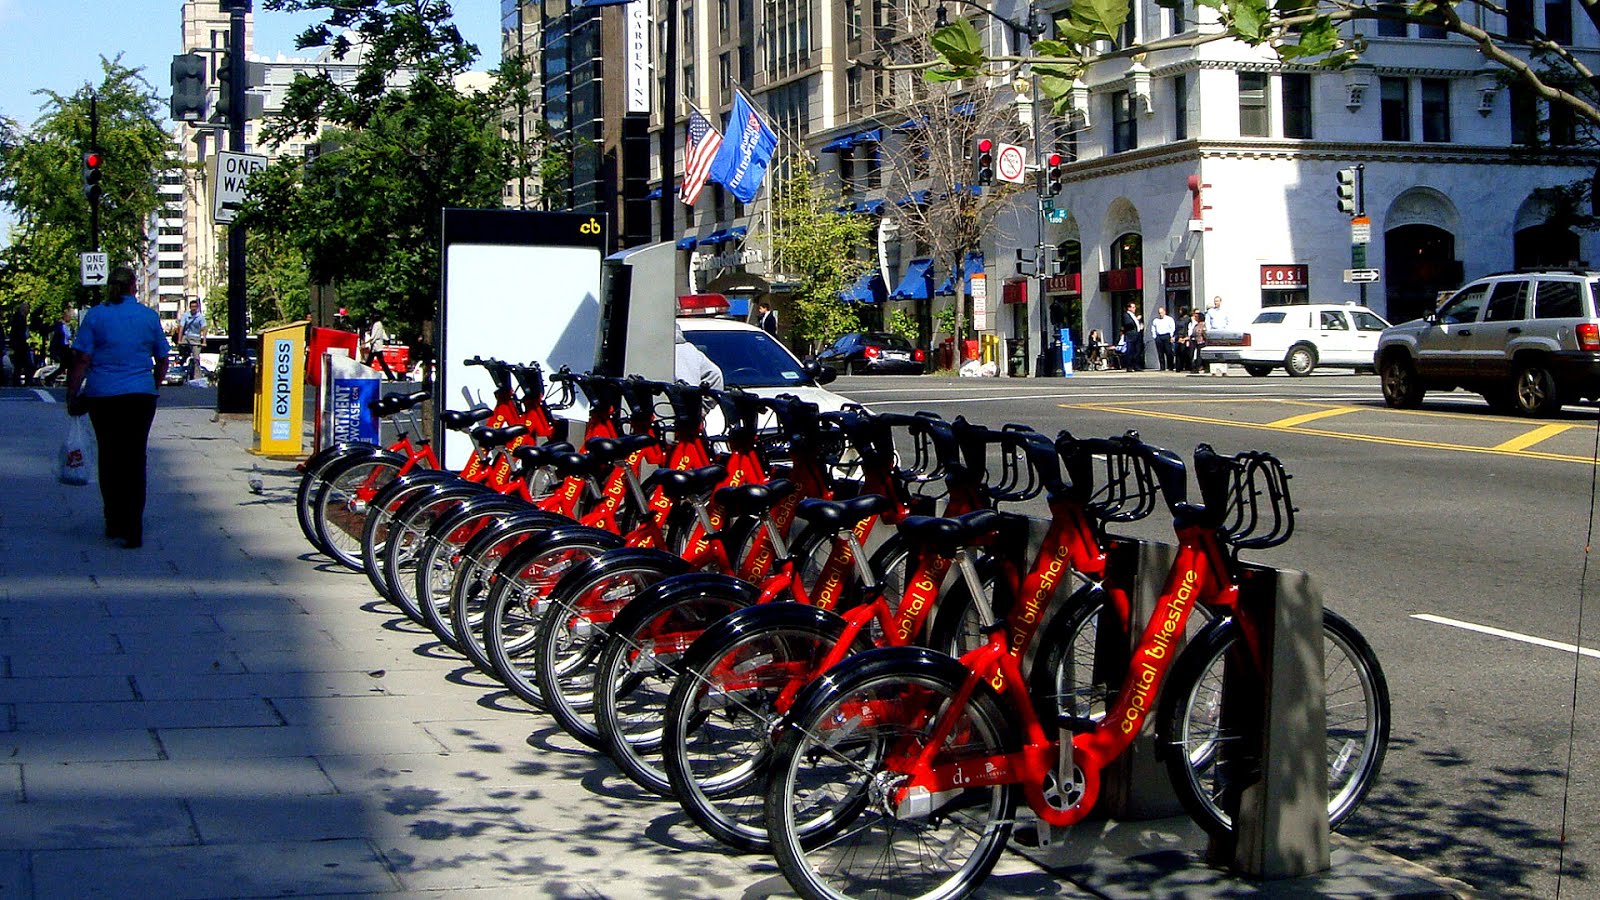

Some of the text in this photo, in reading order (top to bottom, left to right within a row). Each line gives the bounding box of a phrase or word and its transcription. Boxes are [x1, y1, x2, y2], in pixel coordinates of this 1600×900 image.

[224, 176, 249, 193] WA
[86, 254, 104, 263] ONE
[86, 263, 104, 272] WAY
[275, 343, 291, 415] express
[1017, 545, 1068, 625] bikeshare
[1121, 569, 1198, 734] capital bikeshare
